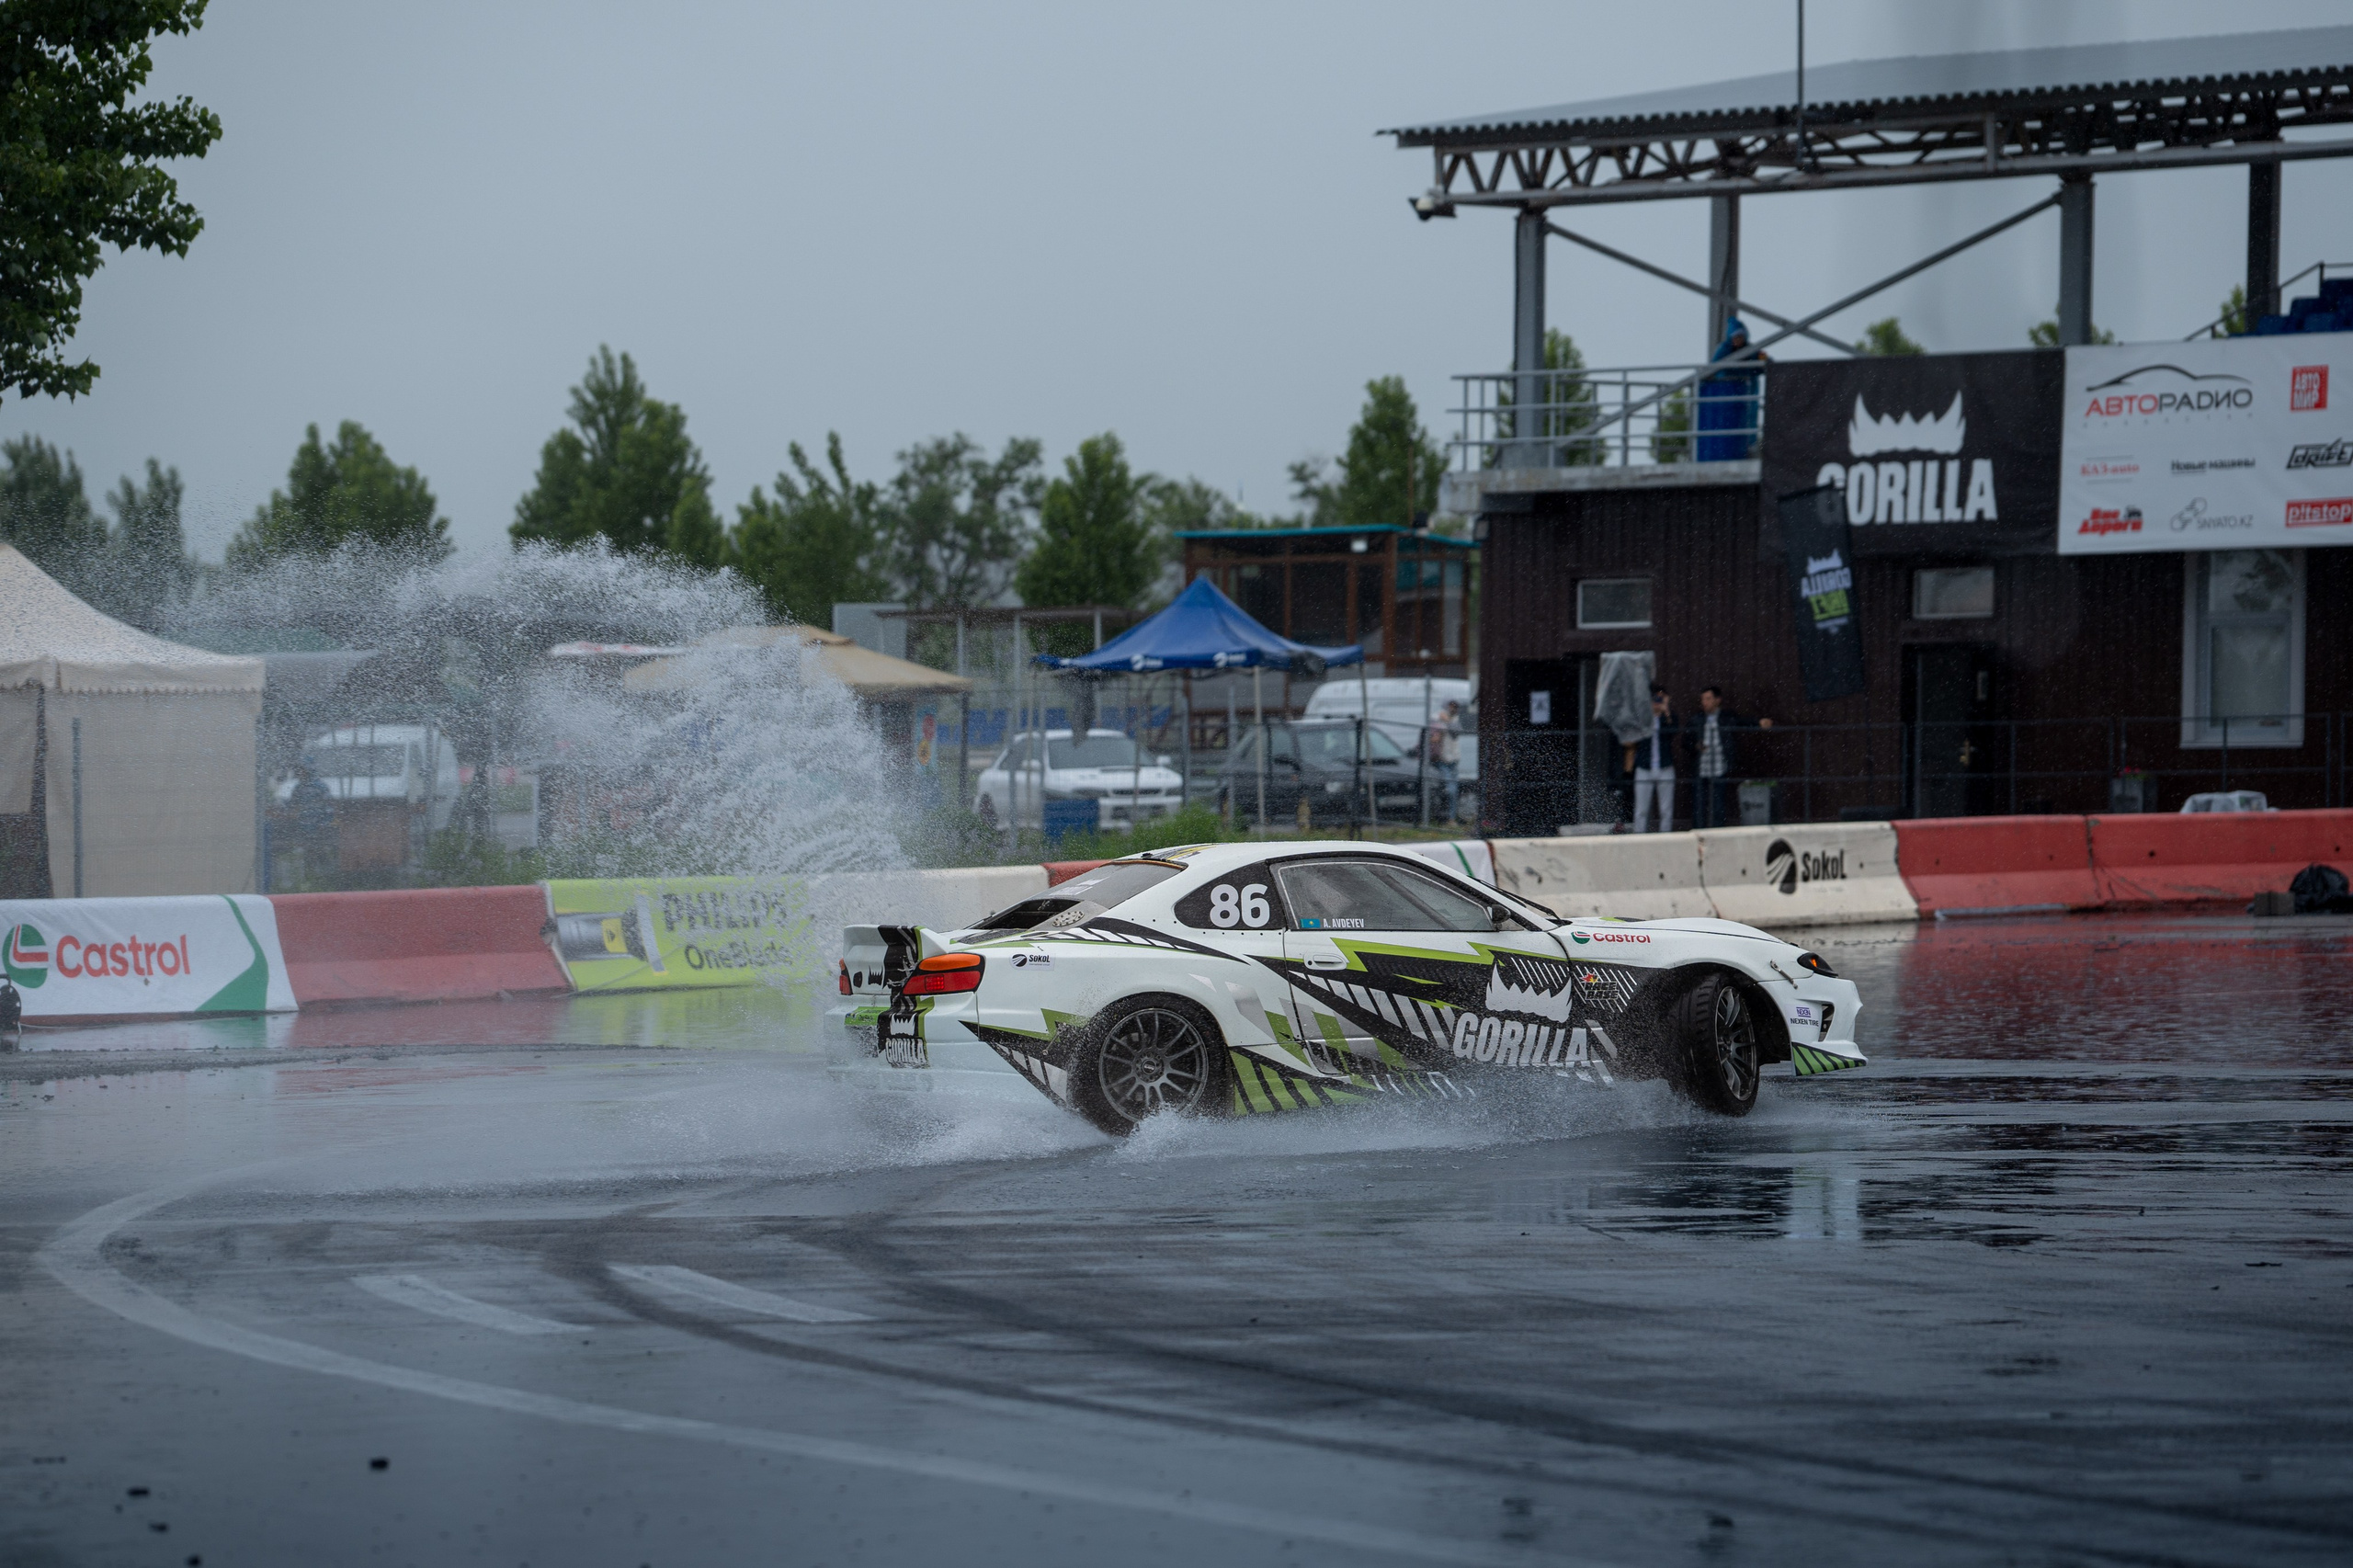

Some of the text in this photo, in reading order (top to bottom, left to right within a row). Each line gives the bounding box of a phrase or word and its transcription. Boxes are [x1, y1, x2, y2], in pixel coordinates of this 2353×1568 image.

[1210, 883, 1270, 928] 86
[1324, 918, 1365, 928] A. AVDEYEV
[1592, 932, 1652, 944] Castrol
[56, 934, 191, 979] Castrol
[1790, 1017, 1820, 1028] NEXEN TIRE
[885, 1037, 928, 1068] GORILLA
[1453, 1012, 1591, 1068] GORILLA
